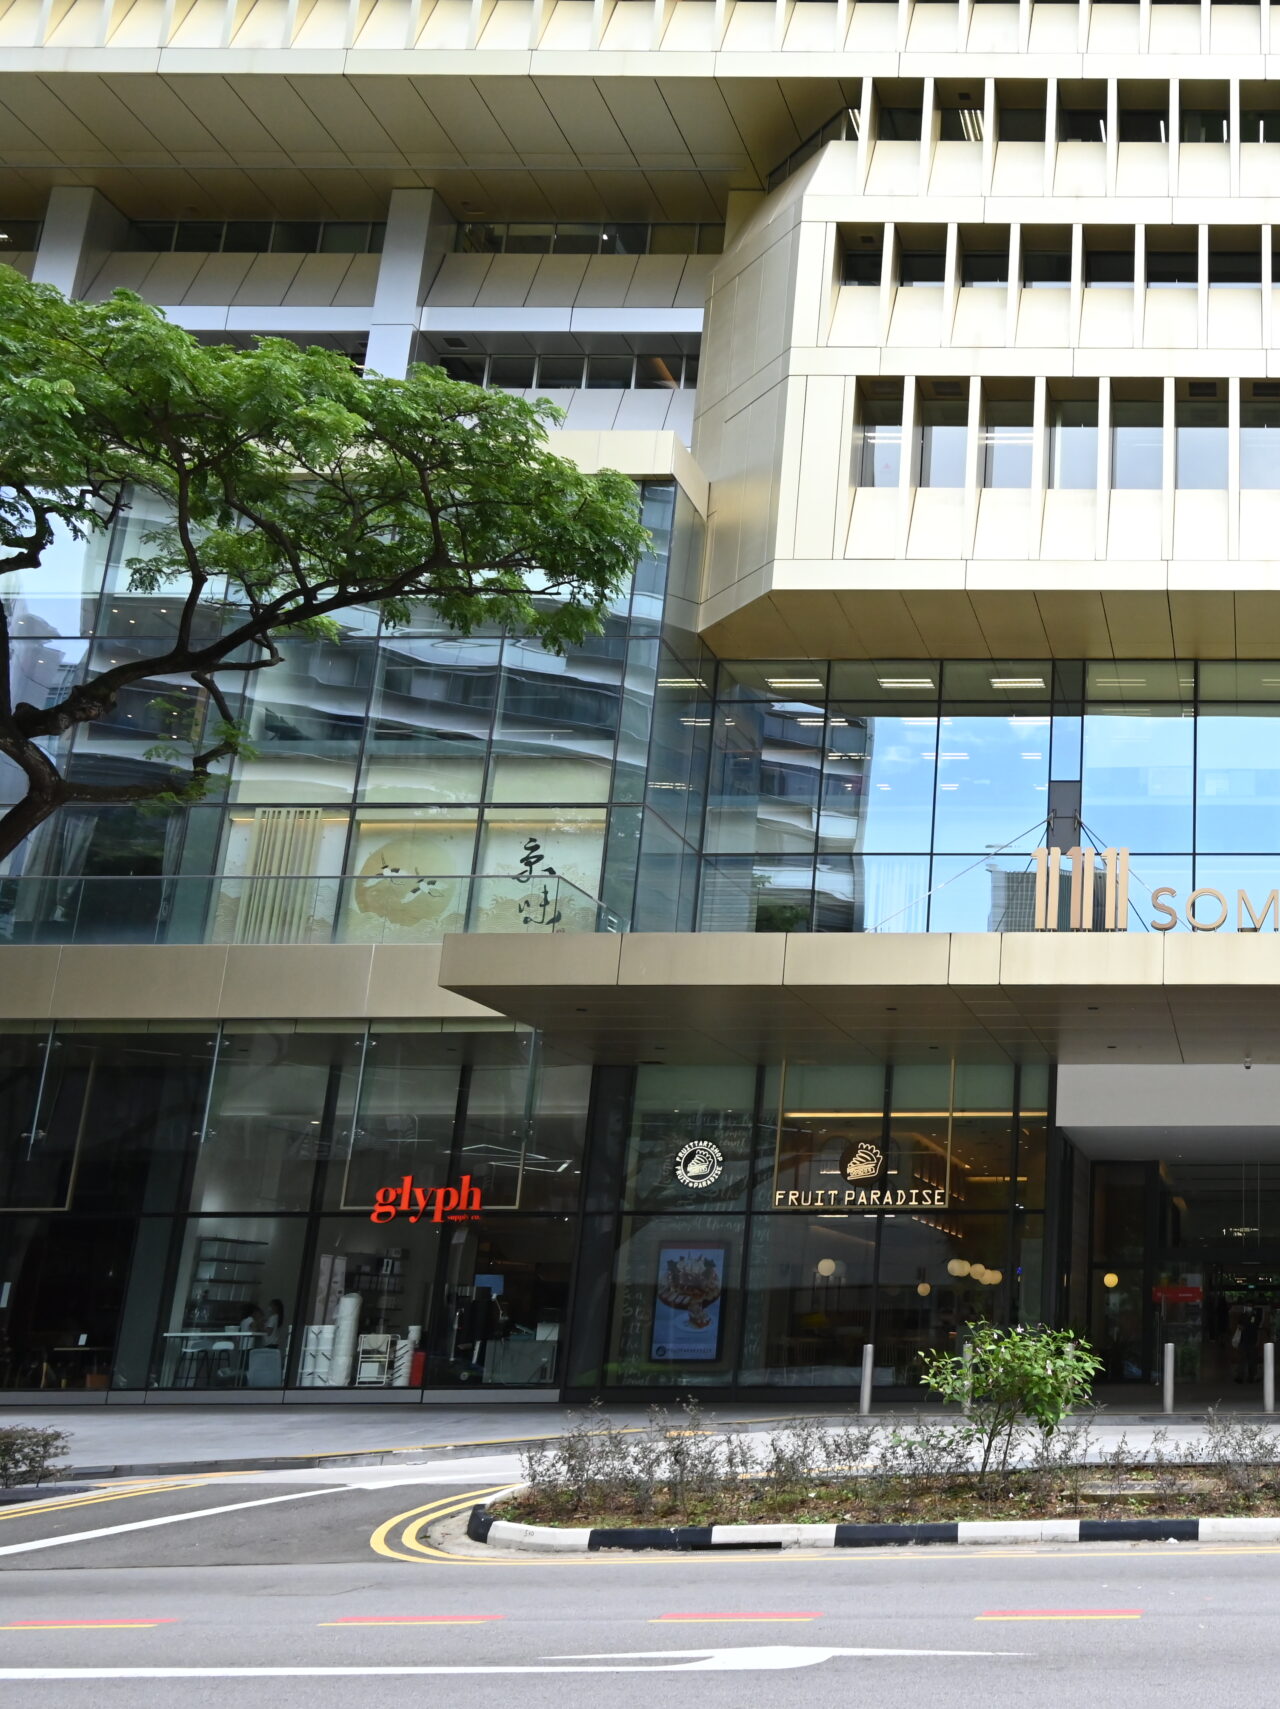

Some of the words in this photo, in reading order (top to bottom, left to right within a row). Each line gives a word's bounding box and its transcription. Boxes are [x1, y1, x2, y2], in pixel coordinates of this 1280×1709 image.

[370, 1175, 483, 1223] glyph
[775, 1191, 838, 1206] FRUIT
[844, 1190, 945, 1206] PARADISE
